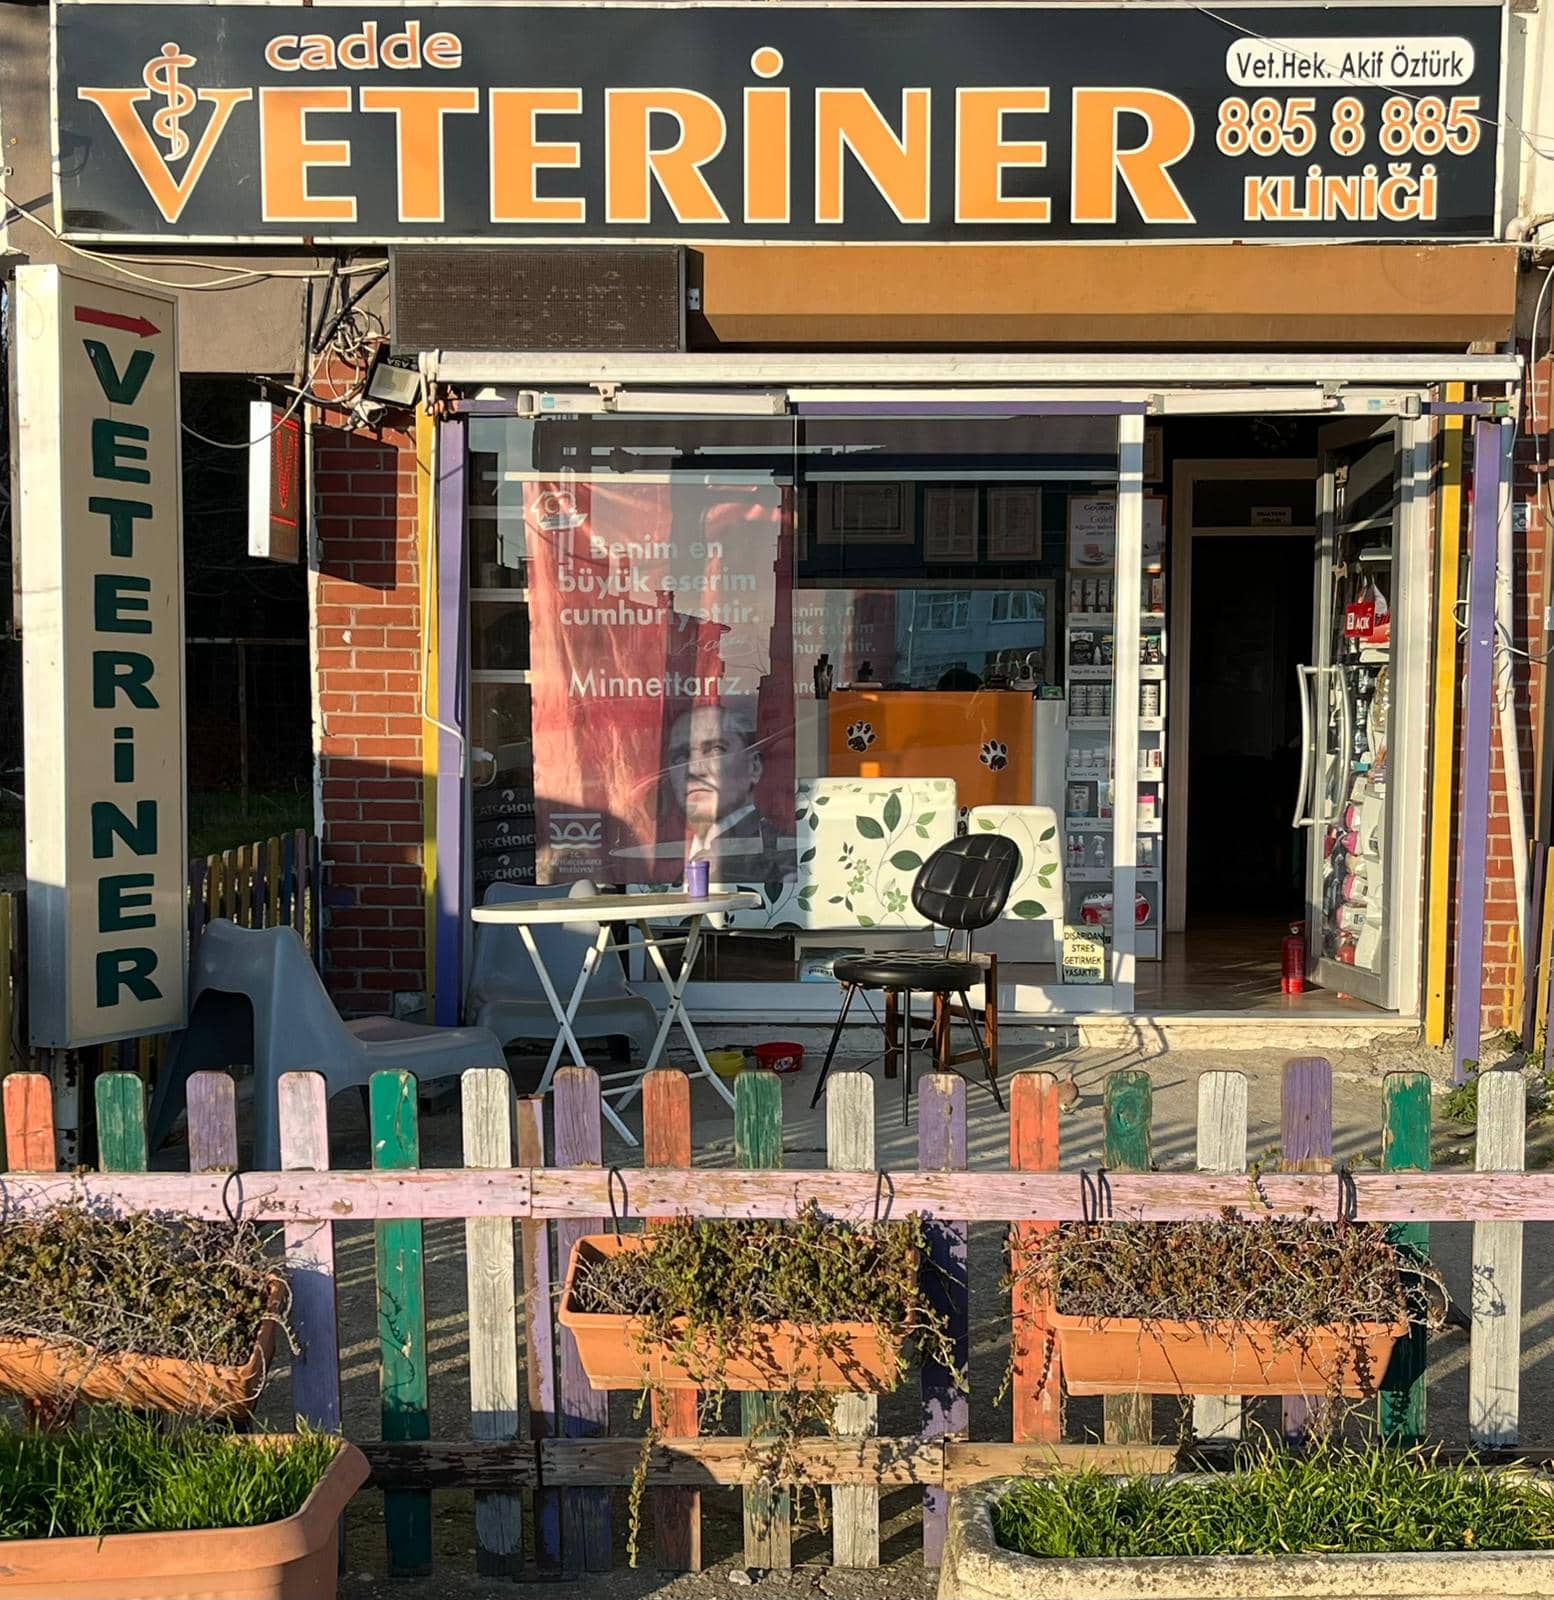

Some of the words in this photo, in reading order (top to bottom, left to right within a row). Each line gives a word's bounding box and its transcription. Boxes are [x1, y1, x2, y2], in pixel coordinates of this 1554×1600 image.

[264, 20, 463, 71] cadde
[1340, 50, 1384, 79] Akif
[1391, 45, 1464, 79] Öztürk
[1216, 96, 1317, 157] 885
[1330, 96, 1366, 157] 8
[1378, 95, 1481, 157] 885
[1244, 162, 1438, 221] KLİNİĞİ
[590, 534, 678, 560] Benim
[690, 541, 723, 560] en
[559, 567, 650, 598] büyük
[661, 569, 757, 593] eserim
[559, 601, 761, 632] cumhuriyettir.
[568, 668, 751, 698] Minnettarız.
[1072, 943, 1095, 953] STRES
